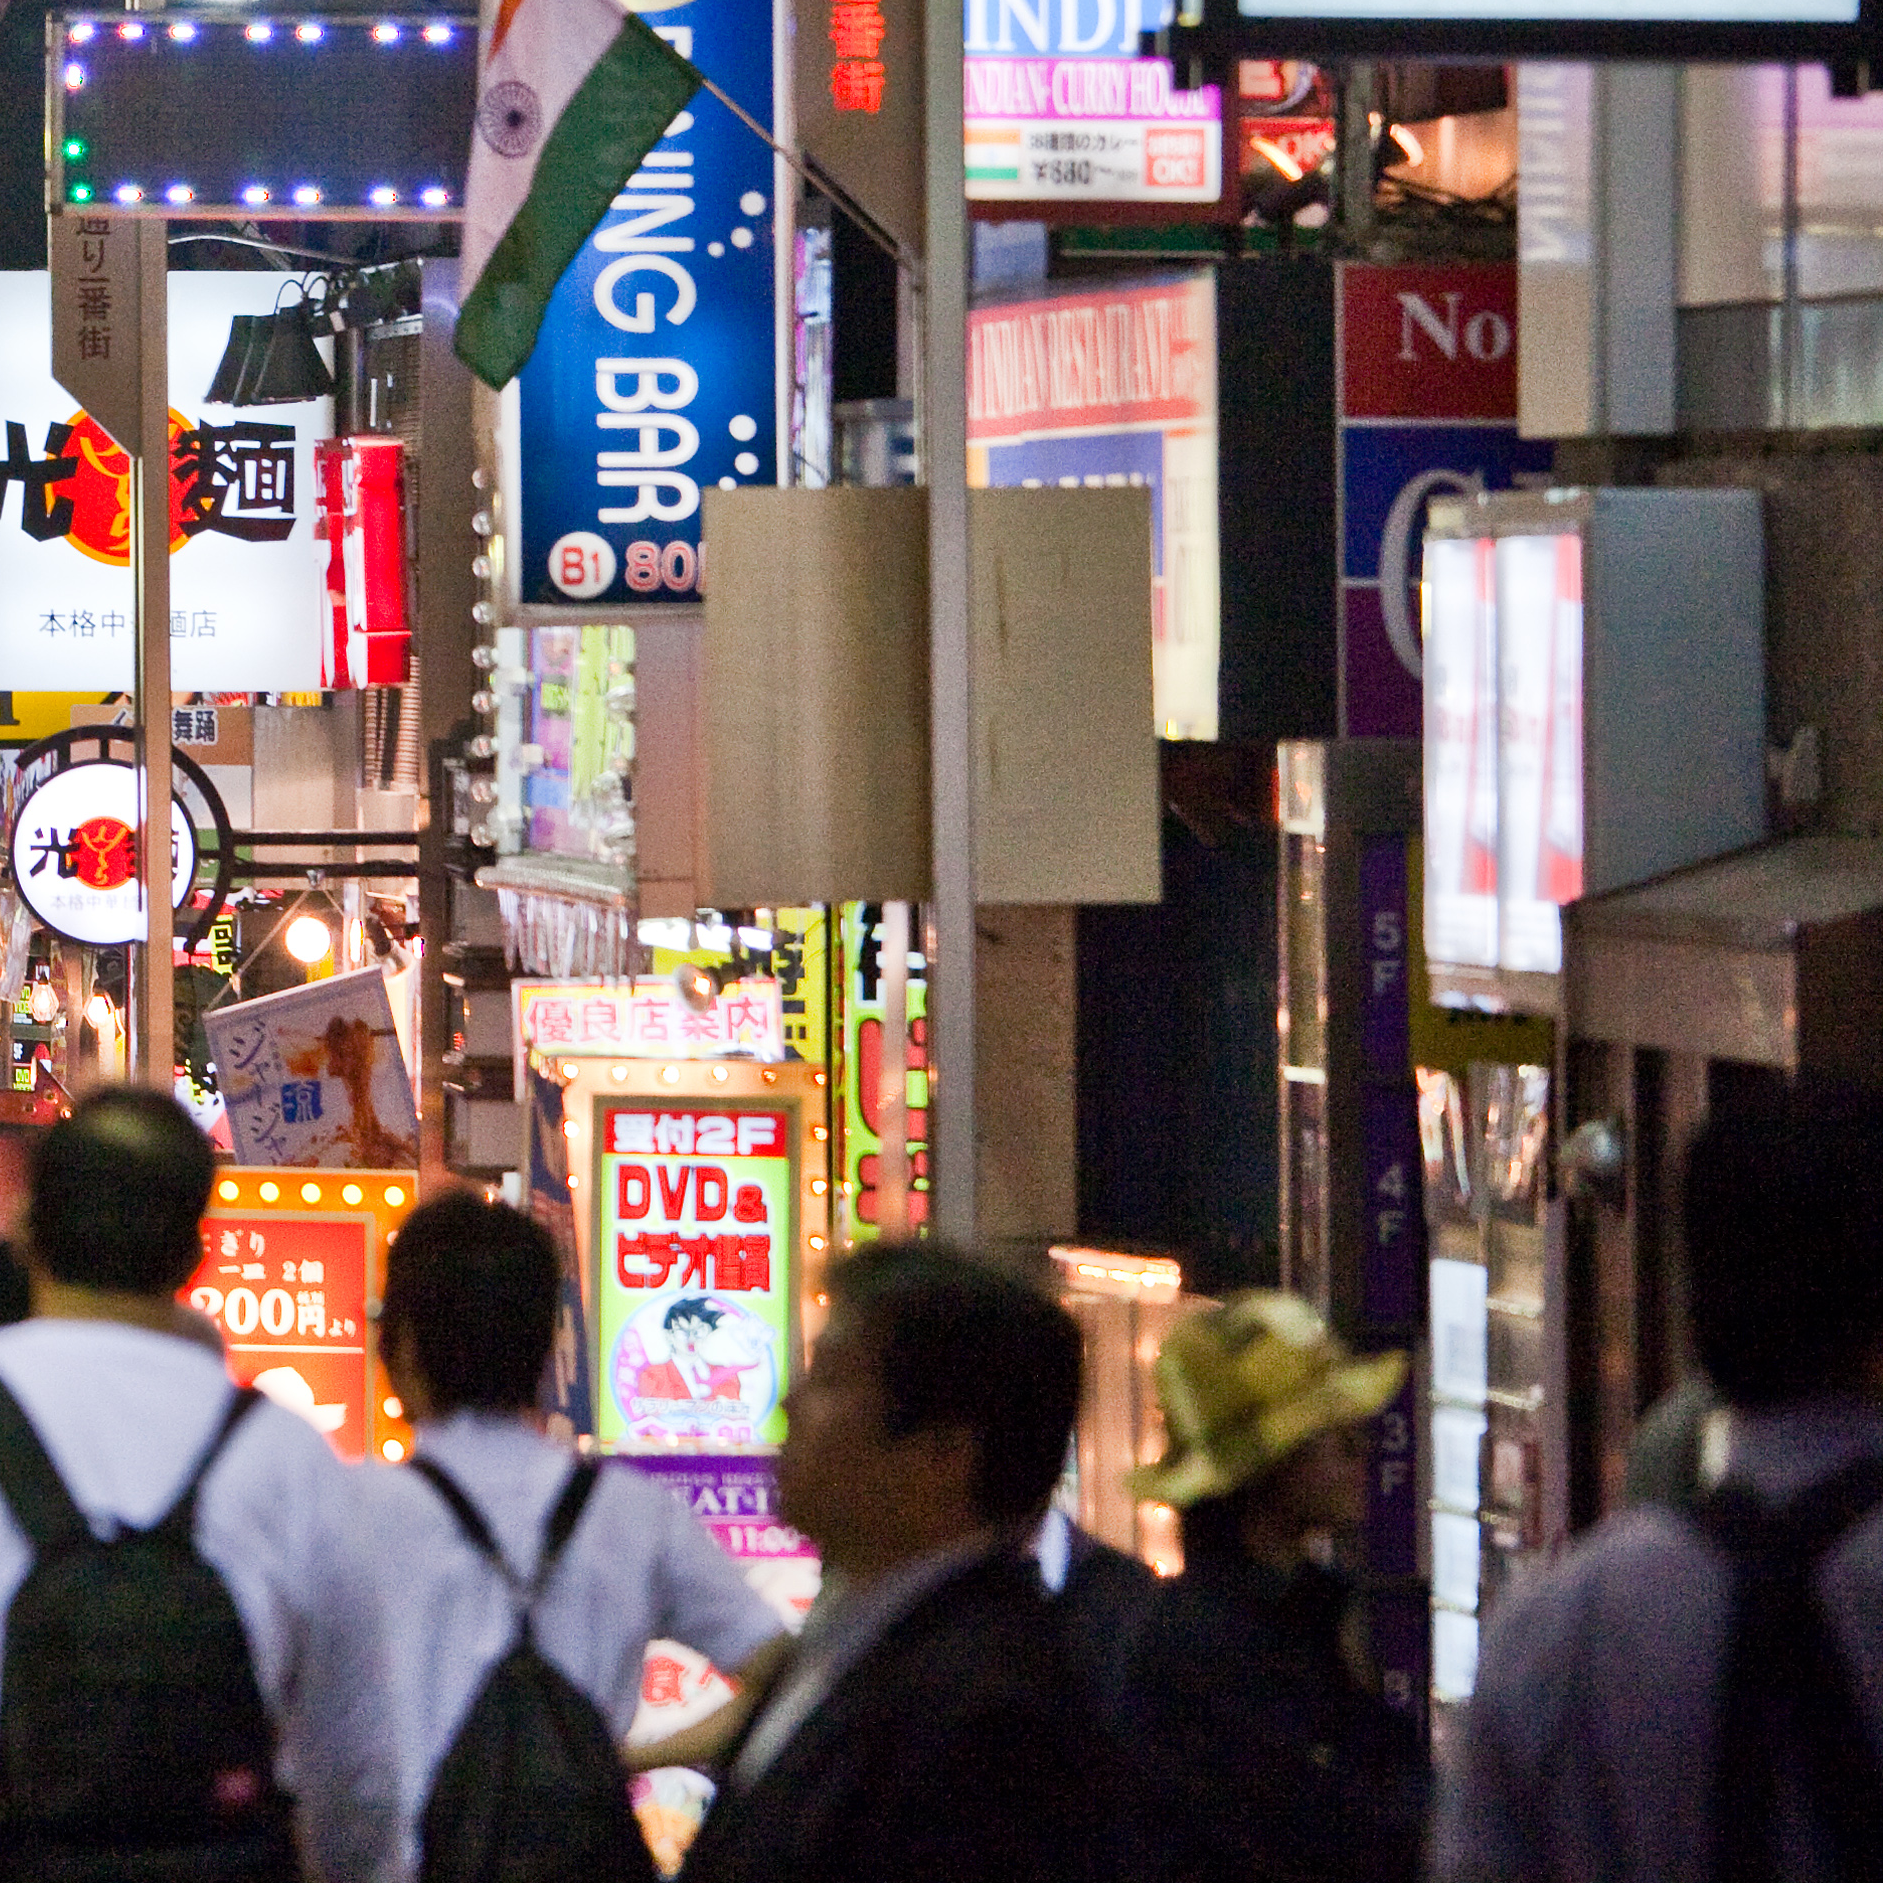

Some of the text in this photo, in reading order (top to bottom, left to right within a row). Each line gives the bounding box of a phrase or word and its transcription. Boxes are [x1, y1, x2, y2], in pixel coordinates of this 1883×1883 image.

[597, 359, 700, 525] BAR
[560, 545, 604, 587] B1
[612, 1117, 780, 1156] 受付2F
